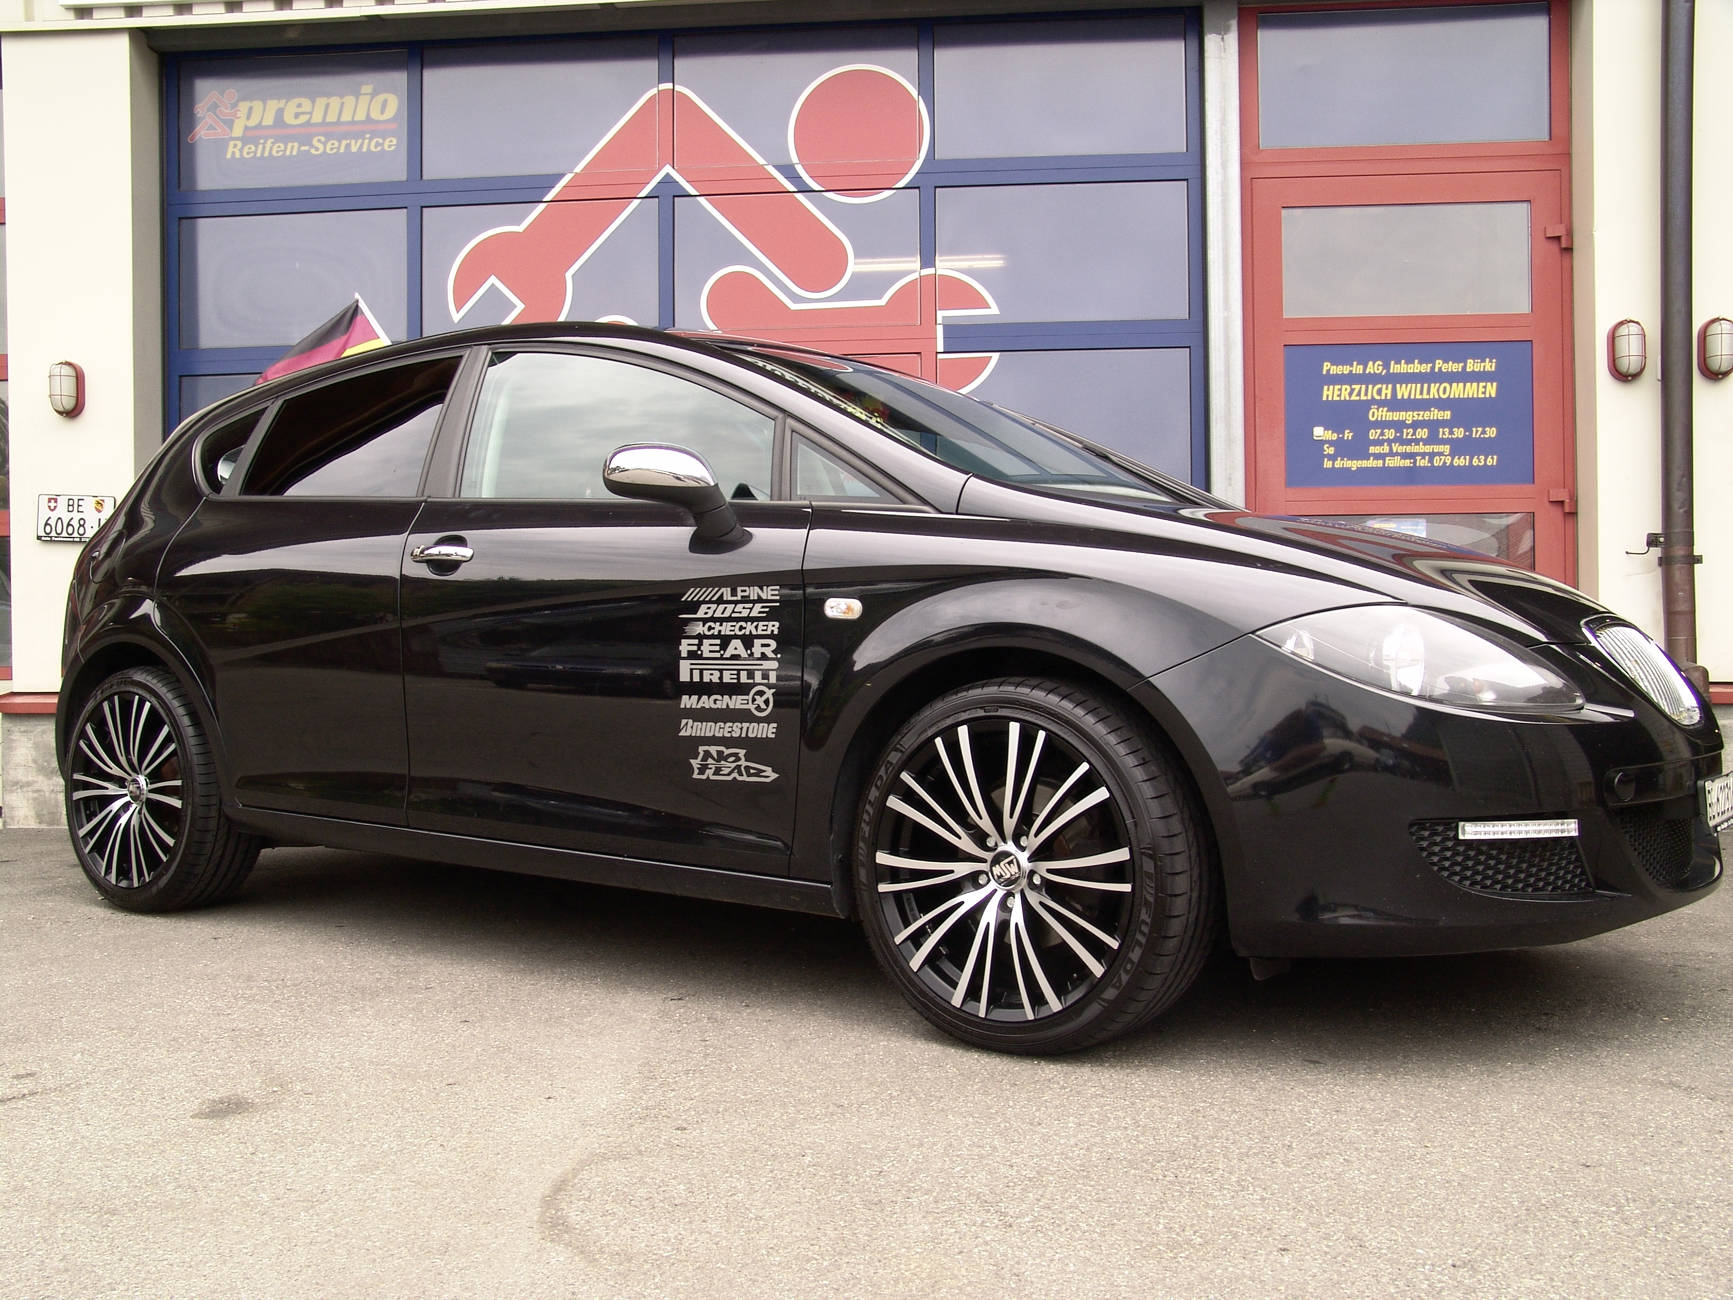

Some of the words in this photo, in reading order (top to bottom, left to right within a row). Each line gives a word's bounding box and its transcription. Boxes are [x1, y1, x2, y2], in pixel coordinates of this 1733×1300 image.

[231, 84, 399, 137] premio
[226, 134, 398, 159] Reifen-Service
[1322, 361, 1364, 375] Pneu-In
[1365, 360, 1387, 376] AG,
[1389, 359, 1433, 374] Inhaber
[1434, 359, 1465, 373] Peter
[1466, 357, 1497, 372] Bürki
[1322, 383, 1393, 401] HERZLICH
[1396, 382, 1498, 400] WILLKOMMEN
[1368, 405, 1452, 425] Öffnungszeiten
[1344, 429, 1354, 440] Fr
[1368, 428, 1395, 440] 07.30
[1402, 428, 1429, 439] 12.00
[1438, 427, 1465, 439] 13.30
[1471, 427, 1497, 438] 17.30
[1323, 444, 1335, 455] Sa
[1368, 442, 1390, 454] nach
[1391, 441, 1451, 456] Vereinbarung
[1323, 457, 1333, 469] In
[1334, 456, 1384, 471] dringenden
[1384, 455, 1414, 468] Fällen:
[1415, 455, 1432, 467] Tel.
[1433, 455, 1452, 467] 079
[1453, 455, 1470, 467] 661
[1472, 455, 1485, 467] 63
[1486, 455, 1498, 467] 61
[67, 498, 85, 513] BE
[712, 586, 780, 601] ALPINE
[678, 602, 780, 618] BOSE
[701, 621, 780, 636] CHECKER
[679, 659, 779, 684] PIRELLI
[678, 718, 778, 739] BRIDGESTONE
[700, 749, 745, 764] NO
[991, 854, 1019, 880] MSW
